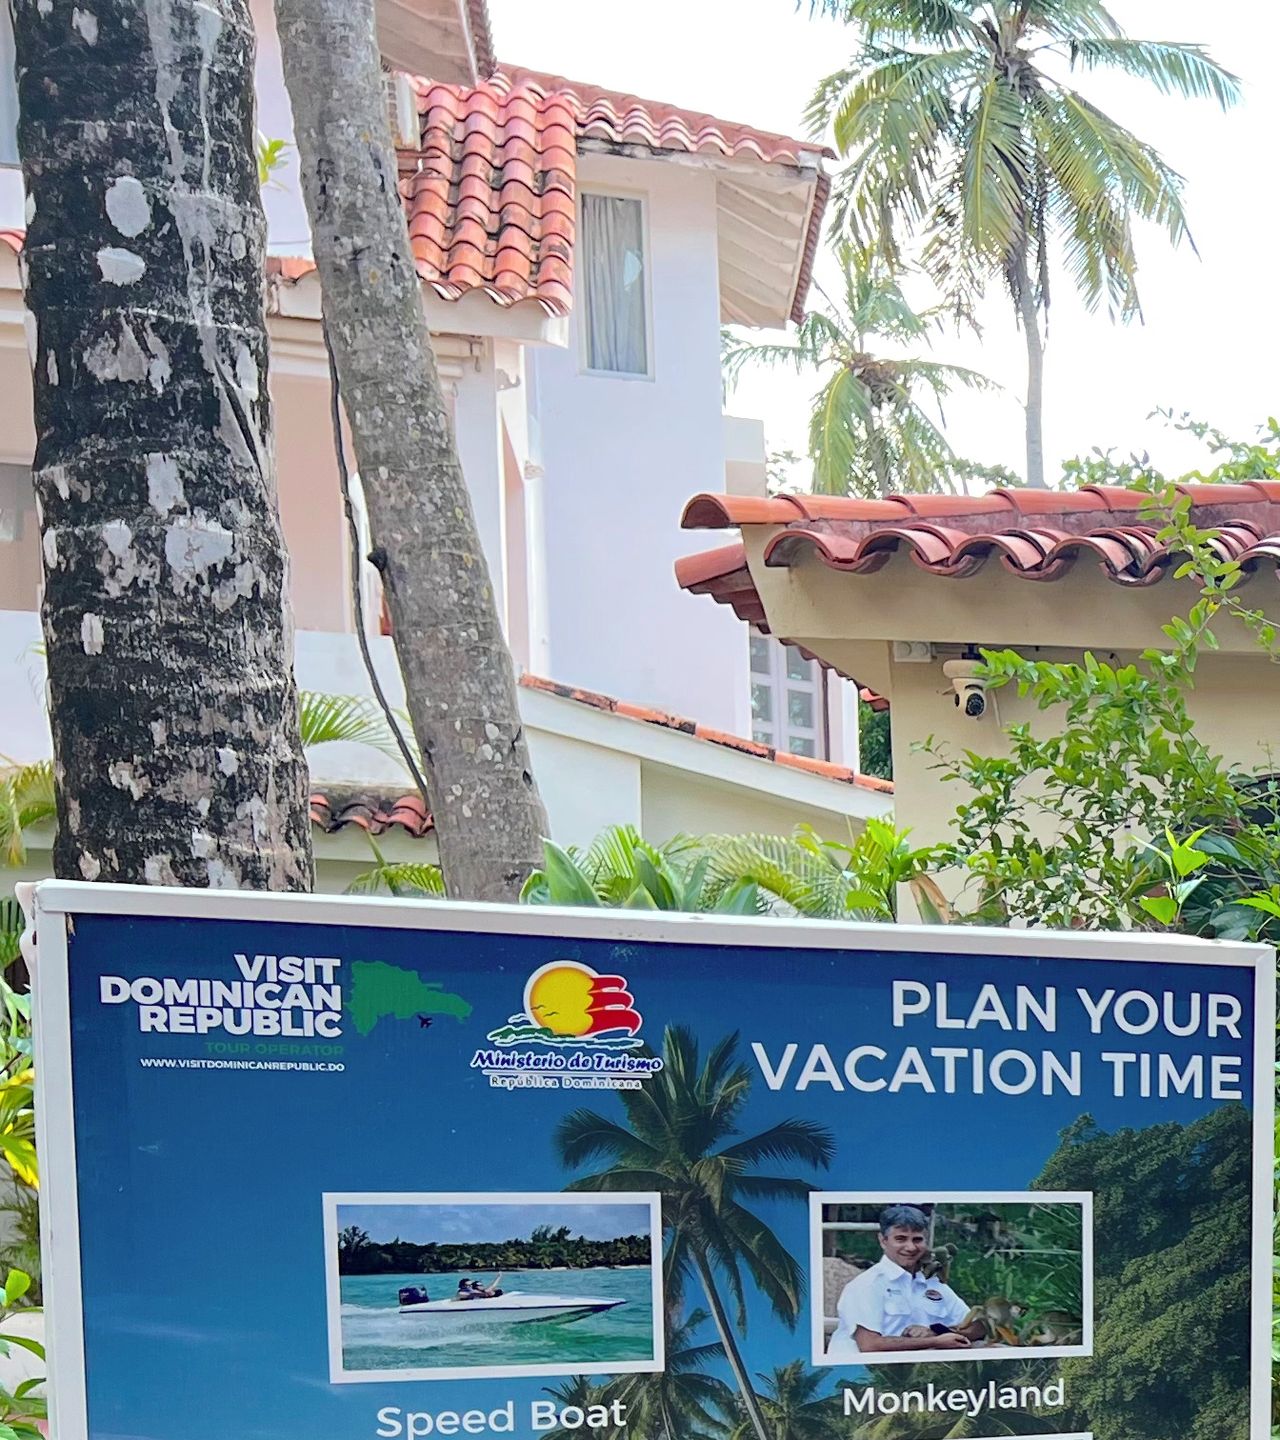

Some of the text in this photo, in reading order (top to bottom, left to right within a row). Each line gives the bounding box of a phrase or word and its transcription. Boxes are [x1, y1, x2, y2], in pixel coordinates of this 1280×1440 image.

[234, 954, 341, 984] VISIT
[100, 975, 342, 1010] DOMINICAN
[139, 1005, 342, 1038] REPUBLIC
[892, 980, 1242, 1039] PLAN YOUR
[205, 1041, 344, 1056] TOUR OPERATOR
[472, 1051, 662, 1072] Ministerio de Turismo
[140, 1058, 345, 1072] WWW.VISITDOMINICANREPUBLIC.DO
[751, 1042, 1242, 1099] VACATION TIME
[562, 1076, 642, 1089] Dominicana
[843, 1378, 1064, 1417] Monkeyland
[531, 1400, 627, 1431] Boat
